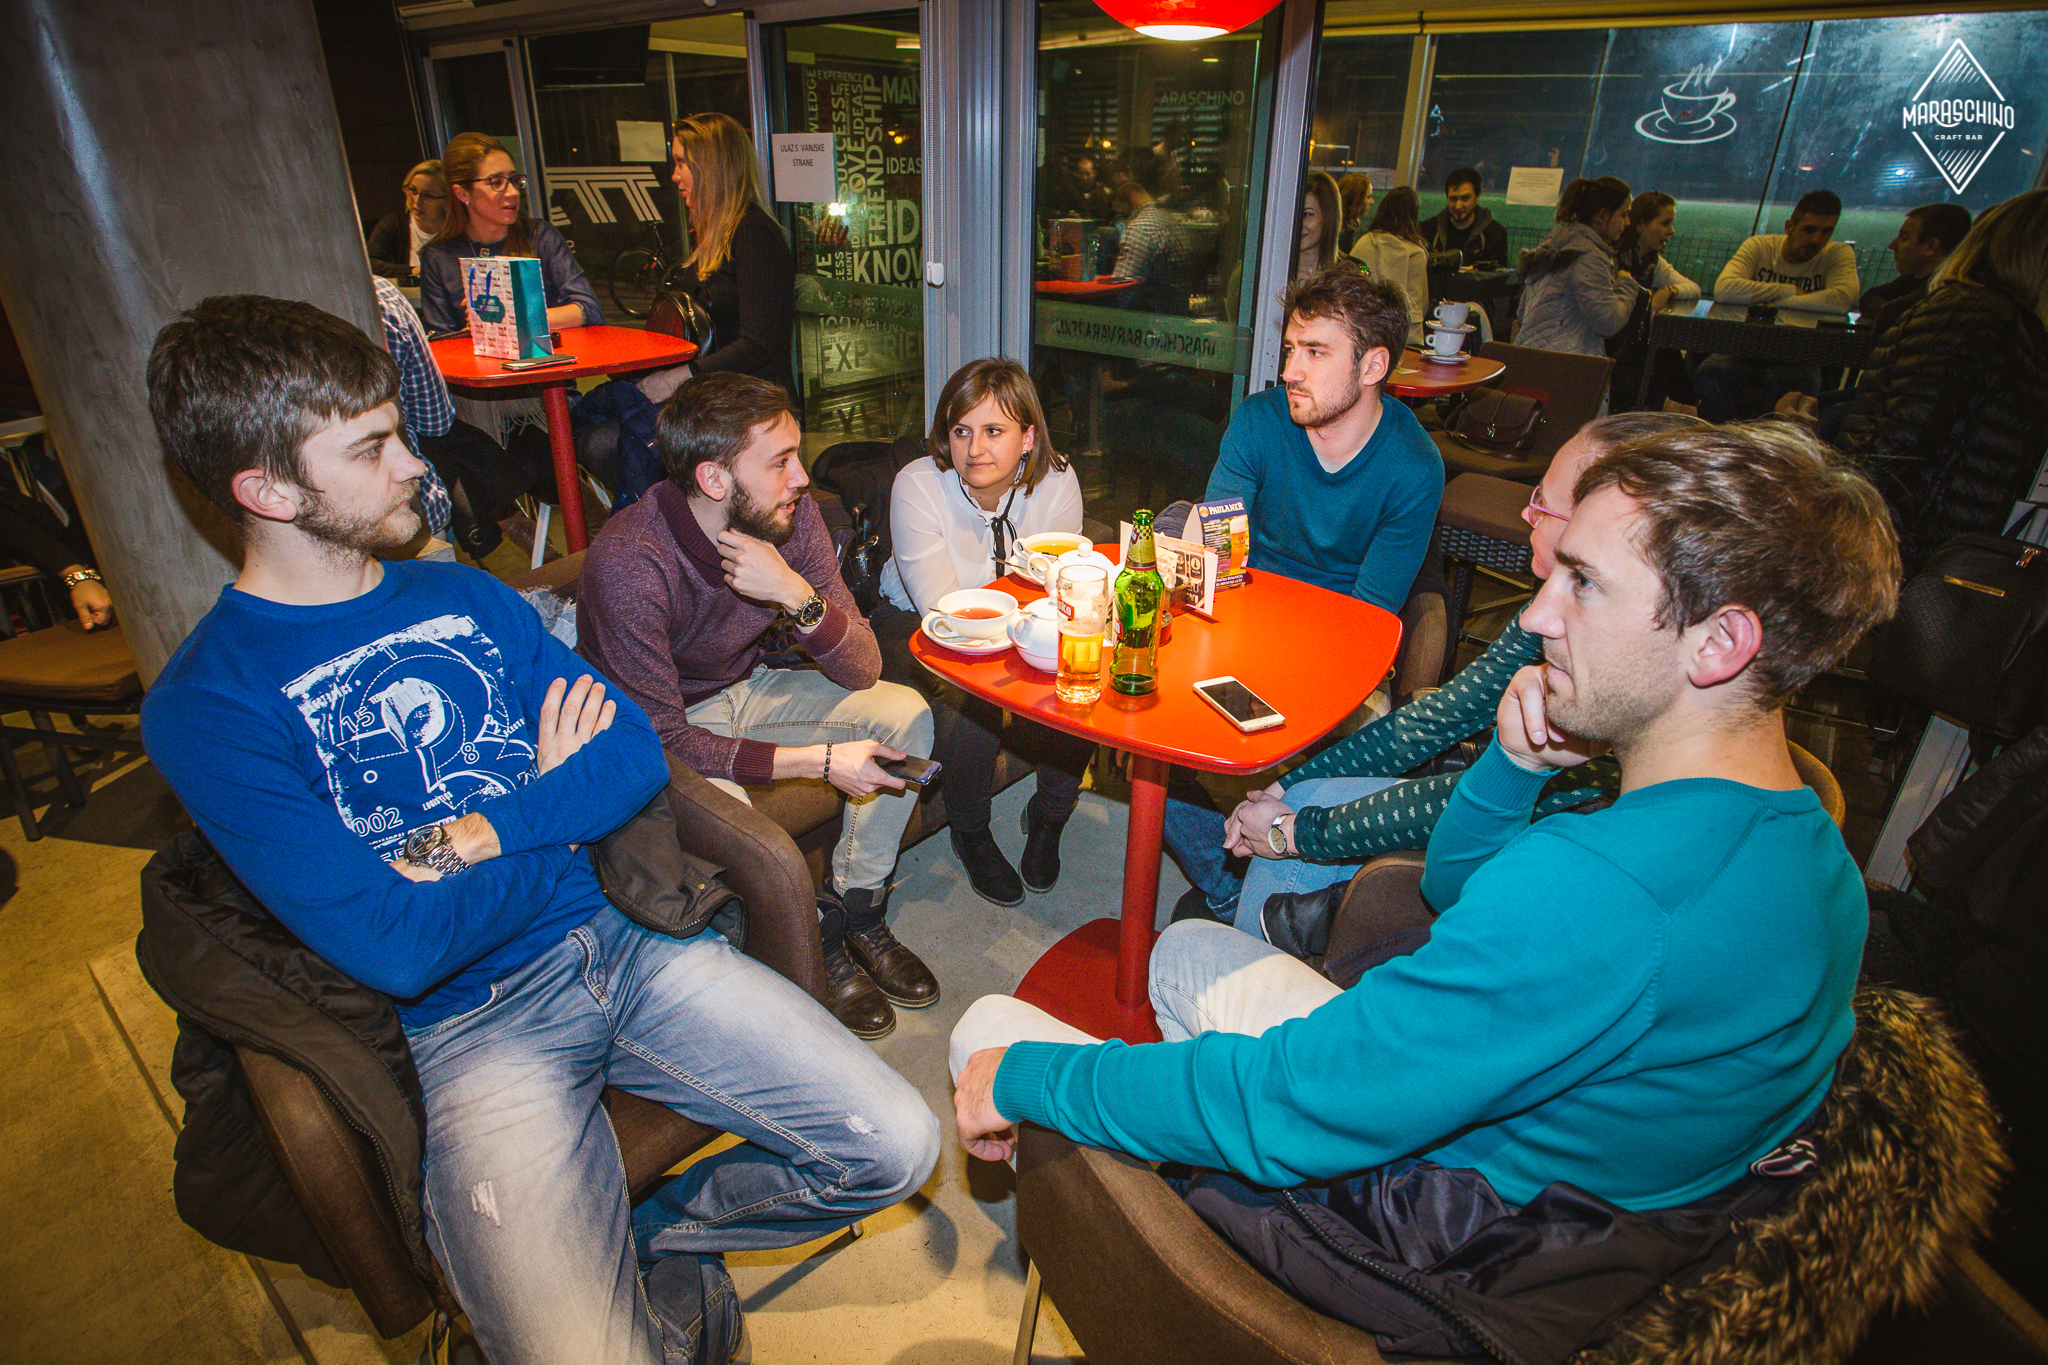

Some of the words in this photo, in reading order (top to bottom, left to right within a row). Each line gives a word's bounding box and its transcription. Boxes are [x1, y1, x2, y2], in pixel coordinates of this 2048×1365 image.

[851, 83, 865, 135] IDEAS
[780, 144, 795, 153] ULAZ
[801, 143, 825, 153] VANJSKE
[863, 73, 886, 247] FRIENDSHIP
[792, 158, 814, 167] STRANE
[1208, 502, 1244, 516] PAULANER
[341, 705, 376, 734] 15
[460, 741, 480, 765] 8
[352, 807, 404, 837] 002
